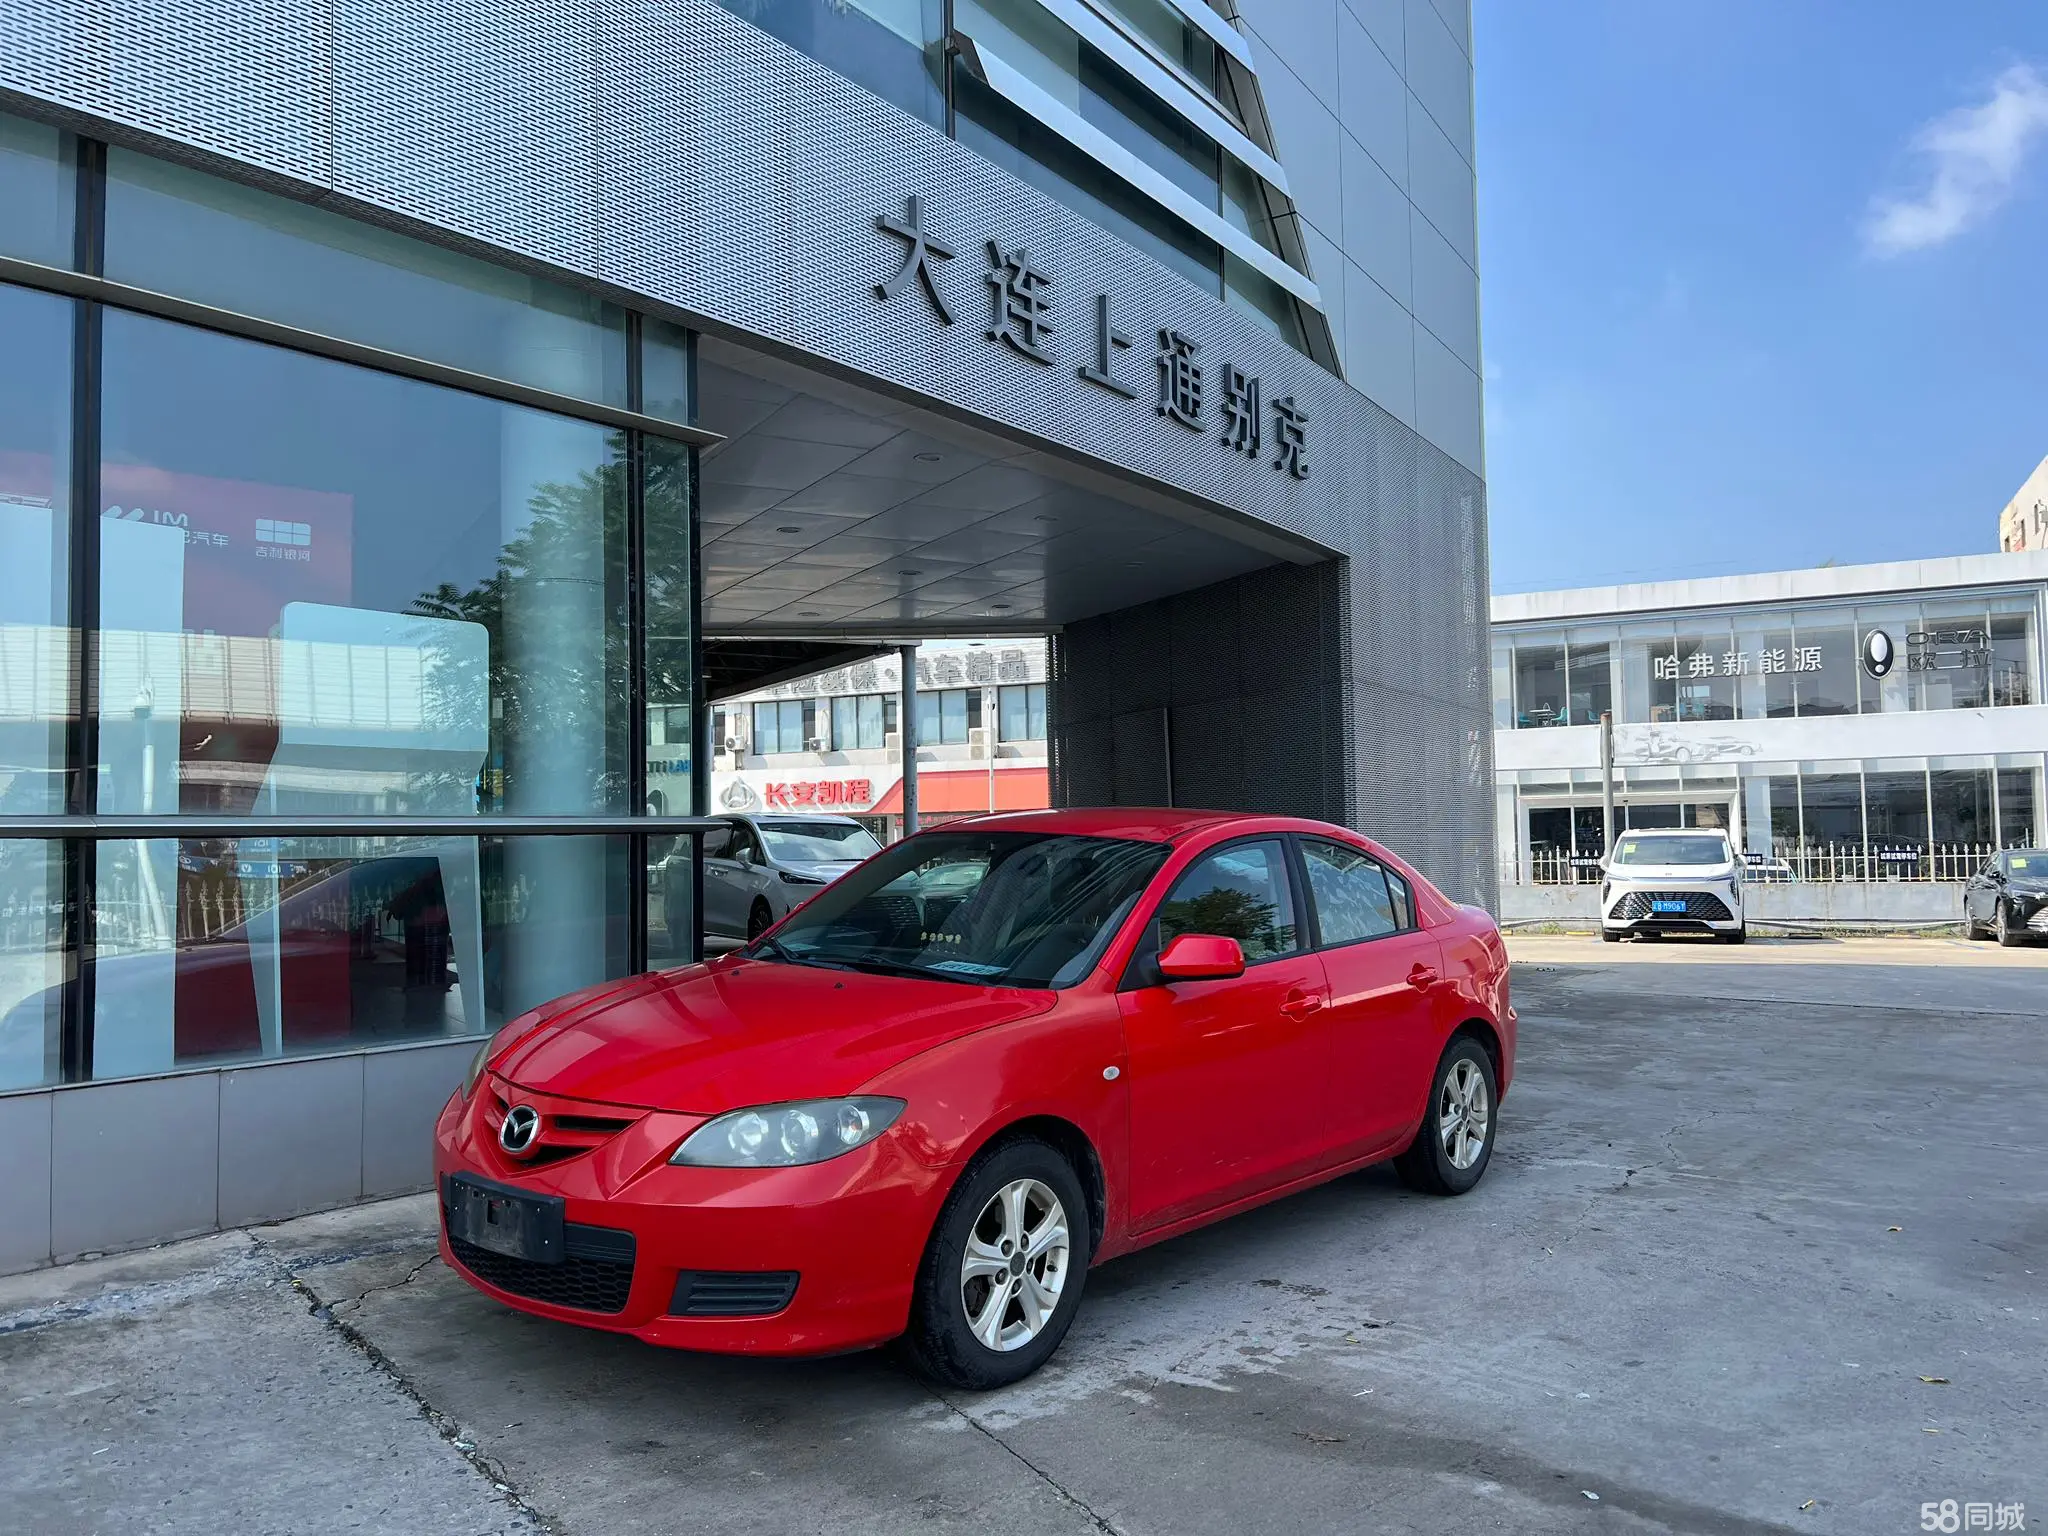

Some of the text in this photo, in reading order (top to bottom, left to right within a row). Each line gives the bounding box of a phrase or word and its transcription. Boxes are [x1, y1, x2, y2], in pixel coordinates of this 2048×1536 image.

[873, 194, 1310, 480] 大连上通别克
[255, 545, 311, 562] 吉利银河
[1905, 627, 1991, 646] ORA
[1653, 645, 1823, 681] 哈弗新能源
[1907, 648, 1993, 673] 欧拉
[764, 778, 872, 807] 长安凯程
